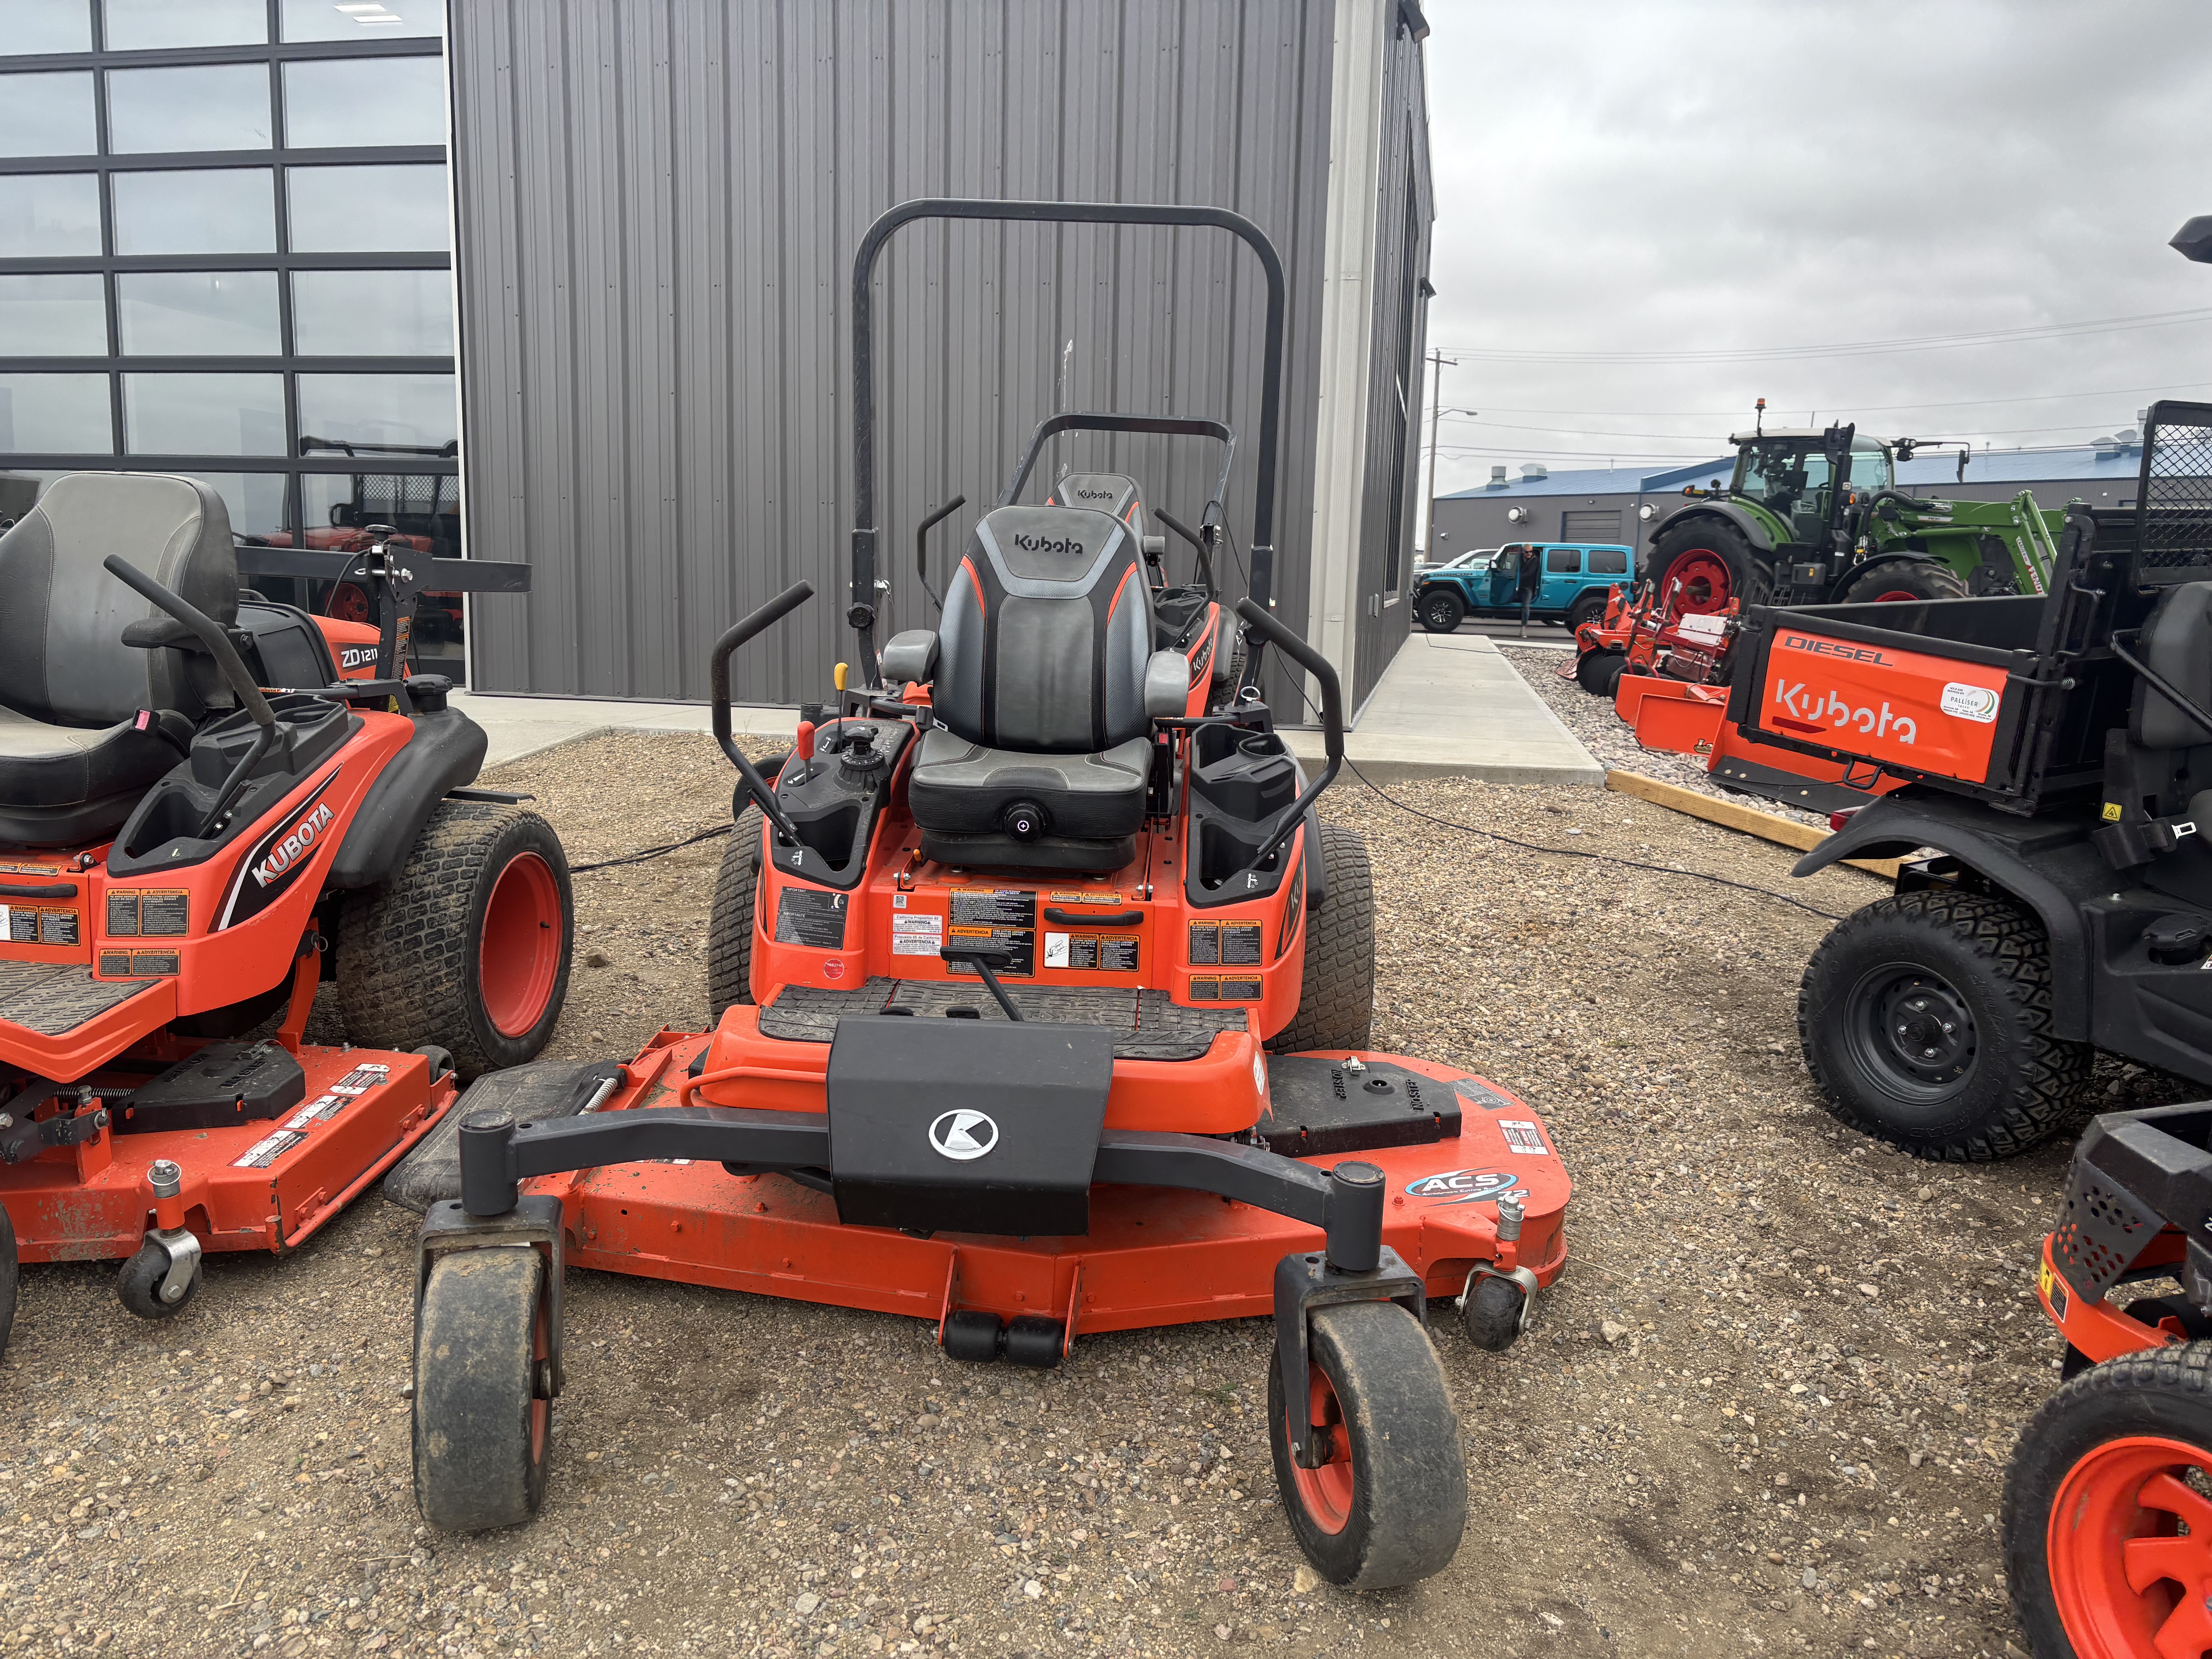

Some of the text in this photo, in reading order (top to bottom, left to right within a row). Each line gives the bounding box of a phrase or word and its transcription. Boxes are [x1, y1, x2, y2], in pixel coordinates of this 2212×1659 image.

[1078, 490, 1112, 499] Kubota
[1015, 534, 1083, 555] Kubota
[1784, 636, 1893, 666] DIESEL
[1776, 678, 1917, 745] Kubota
[1951, 697, 1978, 707] PALLISER
[251, 802, 335, 888] KUBOTA
[1421, 1174, 1499, 1192] ACS
[1498, 1190, 1528, 1199] 72
